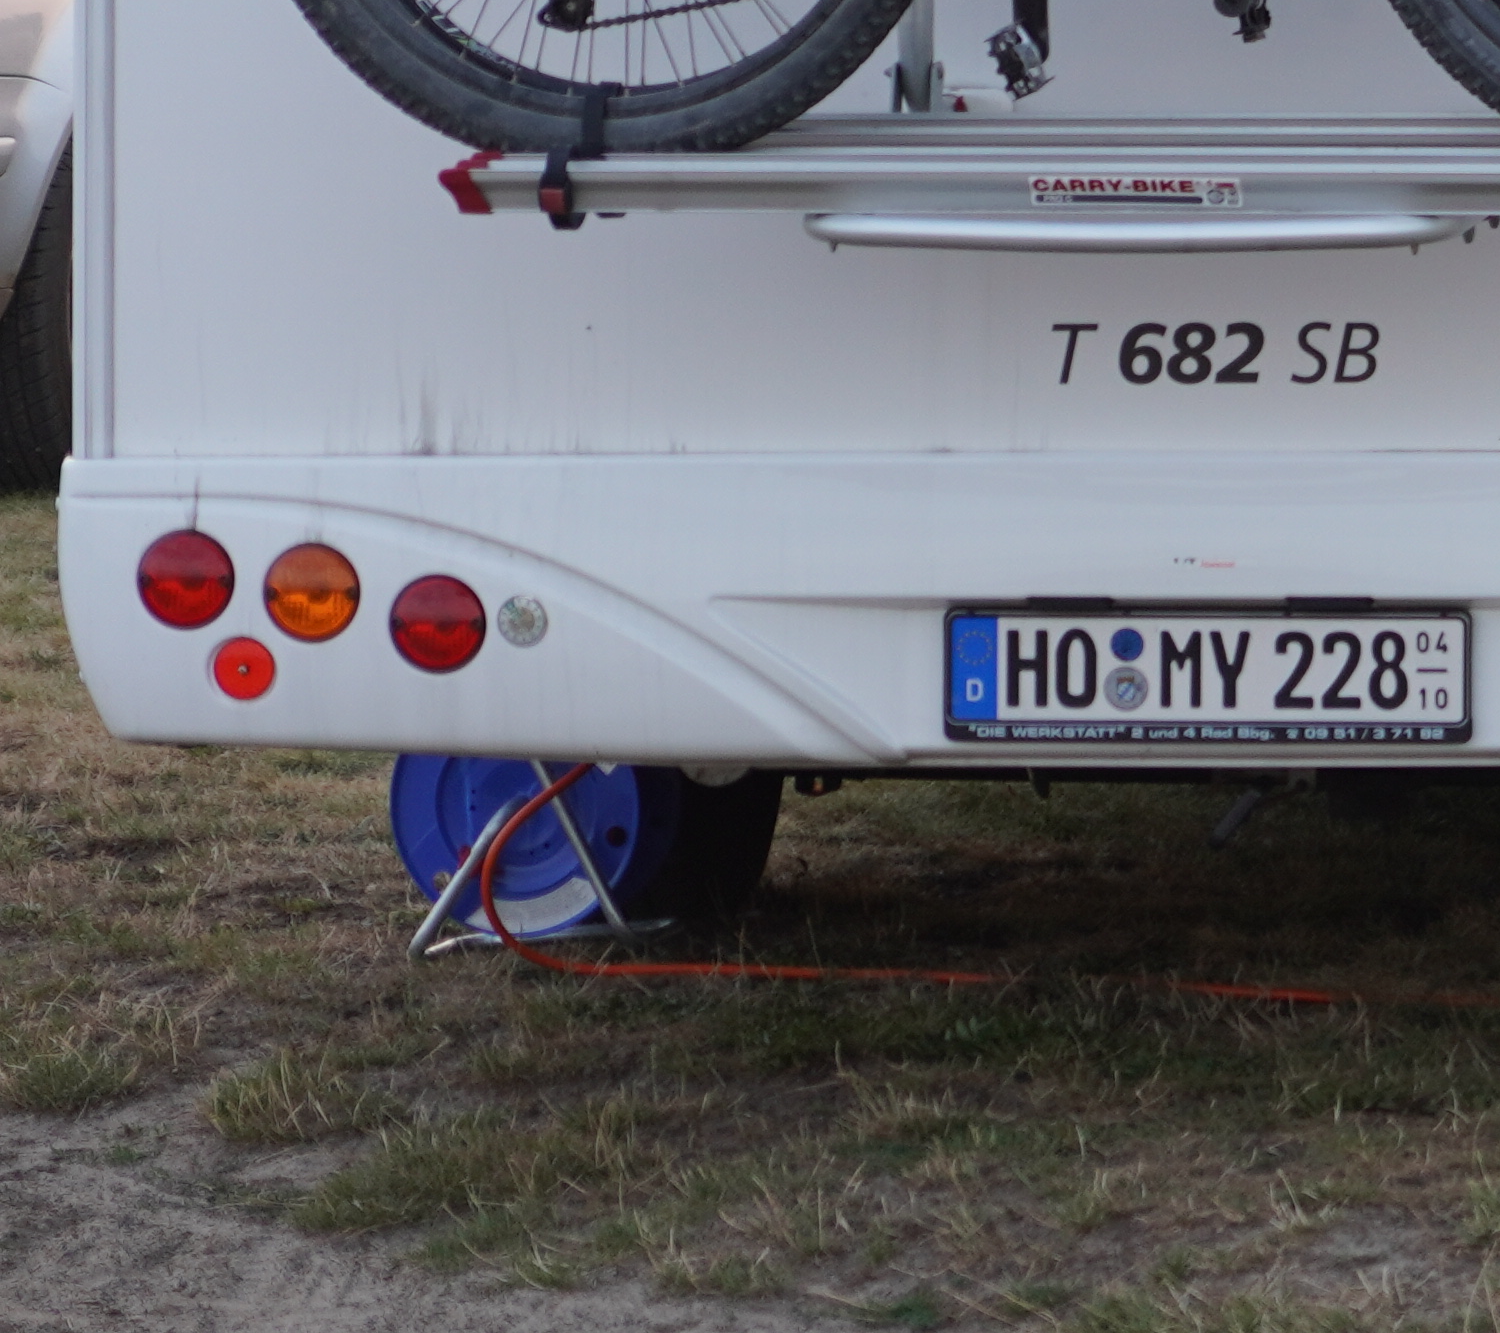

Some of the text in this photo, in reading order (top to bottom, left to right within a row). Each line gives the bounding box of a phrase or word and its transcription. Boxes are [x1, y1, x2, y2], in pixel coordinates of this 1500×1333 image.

[1033, 179, 1195, 193] CARRY-BIKE
[1052, 322, 1380, 385] T 682 SB
[1416, 632, 1448, 653] 04
[1006, 629, 1408, 710] HO MY 228
[965, 679, 984, 703] D
[1419, 688, 1448, 710] 10
[1149, 727, 1178, 739] und
[1183, 727, 1195, 739] 4
